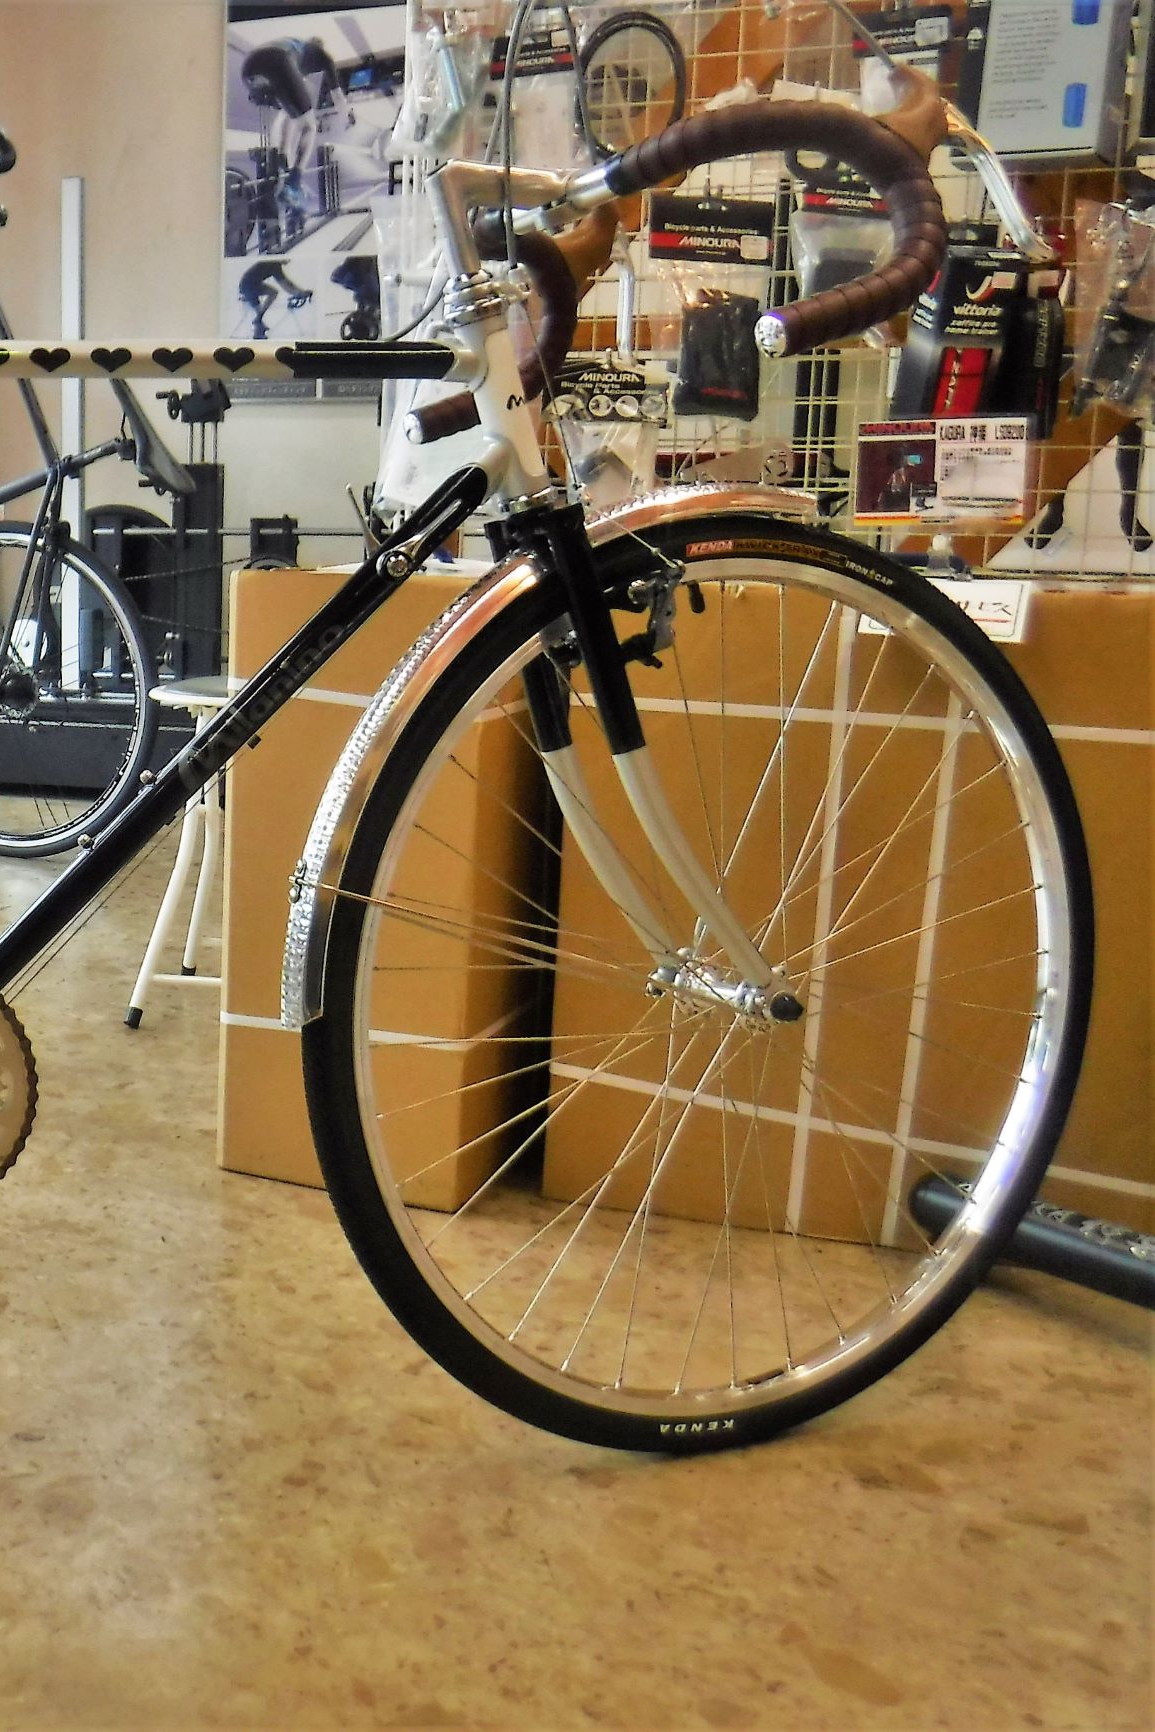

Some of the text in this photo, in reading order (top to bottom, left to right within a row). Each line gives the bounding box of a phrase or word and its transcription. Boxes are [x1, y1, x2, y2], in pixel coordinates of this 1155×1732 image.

[679, 236, 741, 249] MINOURA
[953, 303, 1003, 316] vittoria
[579, 373, 640, 383] MINOURA
[689, 539, 734, 555] KENDA
[846, 558, 867, 576] IRON
[874, 571, 894, 587] CAP
[659, 1418, 735, 1433] KENDA
